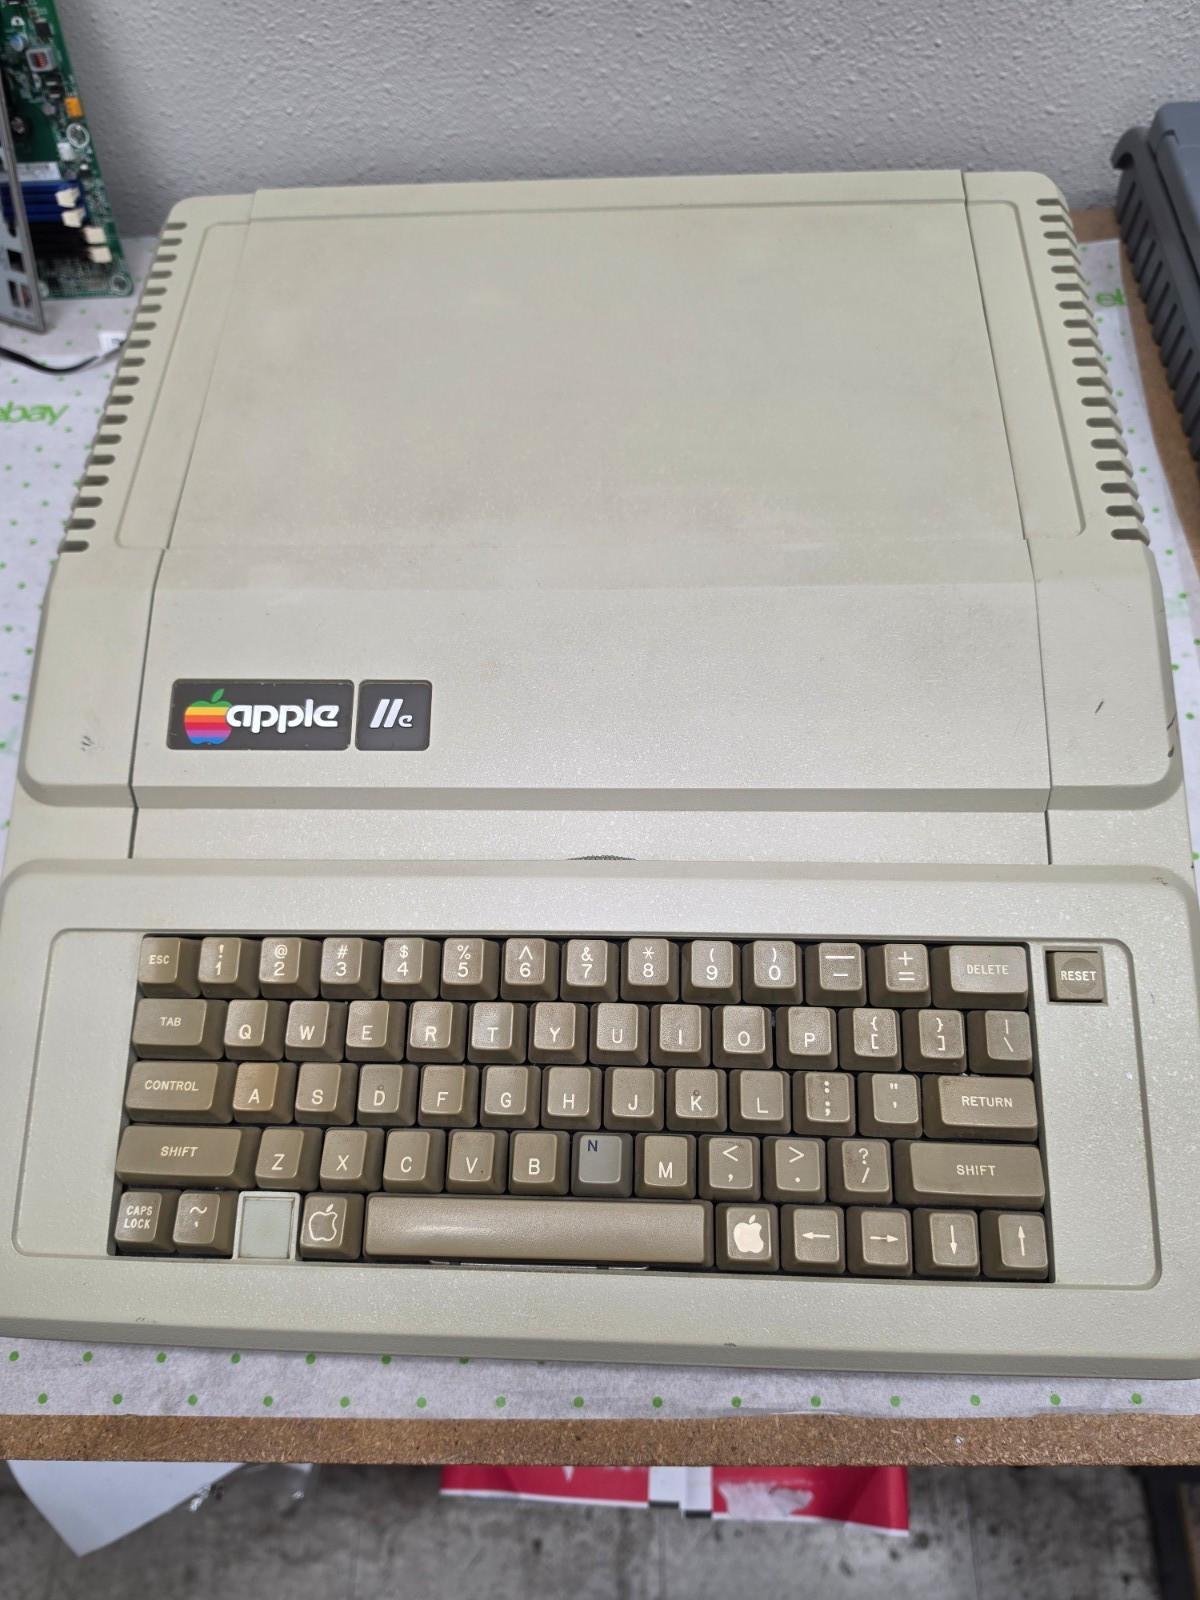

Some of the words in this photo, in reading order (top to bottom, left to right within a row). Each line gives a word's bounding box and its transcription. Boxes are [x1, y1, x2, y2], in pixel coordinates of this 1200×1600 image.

[226, 699, 339, 733] apple
[149, 955, 170, 965] ESC
[274, 962, 285, 976] 2
[336, 961, 347, 976] 3
[397, 962, 409, 976] 4
[458, 963, 468, 977] 5
[520, 963, 531, 977] 6
[582, 964, 592, 978] 7
[643, 963, 654, 977] 8
[706, 965, 718, 980] 9
[769, 966, 781, 980] 0
[966, 965, 1009, 975] DELETE
[1061, 970, 1097, 981] RESET
[160, 1017, 181, 1027] TAB
[239, 1025, 252, 1039] Q
[299, 1025, 315, 1040] W
[362, 1025, 373, 1040] E
[425, 1026, 437, 1041] R
[487, 1027, 498, 1042] T
[549, 1027, 560, 1042] Y
[612, 1029, 622, 1043] U
[738, 1031, 750, 1046] O
[805, 1032, 815, 1047] P
[145, 1080, 199, 1091] CONTROL
[248, 1089, 260, 1104] A
[312, 1089, 323, 1104] S
[374, 1090, 385, 1105] D
[437, 1092, 448, 1107] F
[501, 1092, 511, 1108] G
[563, 1093, 575, 1109] H
[628, 1094, 638, 1110] J
[691, 1096, 702, 1111] K
[962, 1096, 1013, 1108] RETURN
[757, 1097, 768, 1114] L
[160, 1147, 198, 1157] SHIFT
[588, 1140, 598, 1152] N
[272, 1154, 285, 1171] Z
[336, 1155, 349, 1171] X
[400, 1156, 412, 1173] C
[466, 1157, 478, 1174] V
[529, 1158, 540, 1175] B
[658, 1162, 672, 1178] M
[956, 1165, 995, 1176] SHIFT
[126, 1206, 152, 1215] CAPS
[124, 1219, 150, 1229] LOCK
